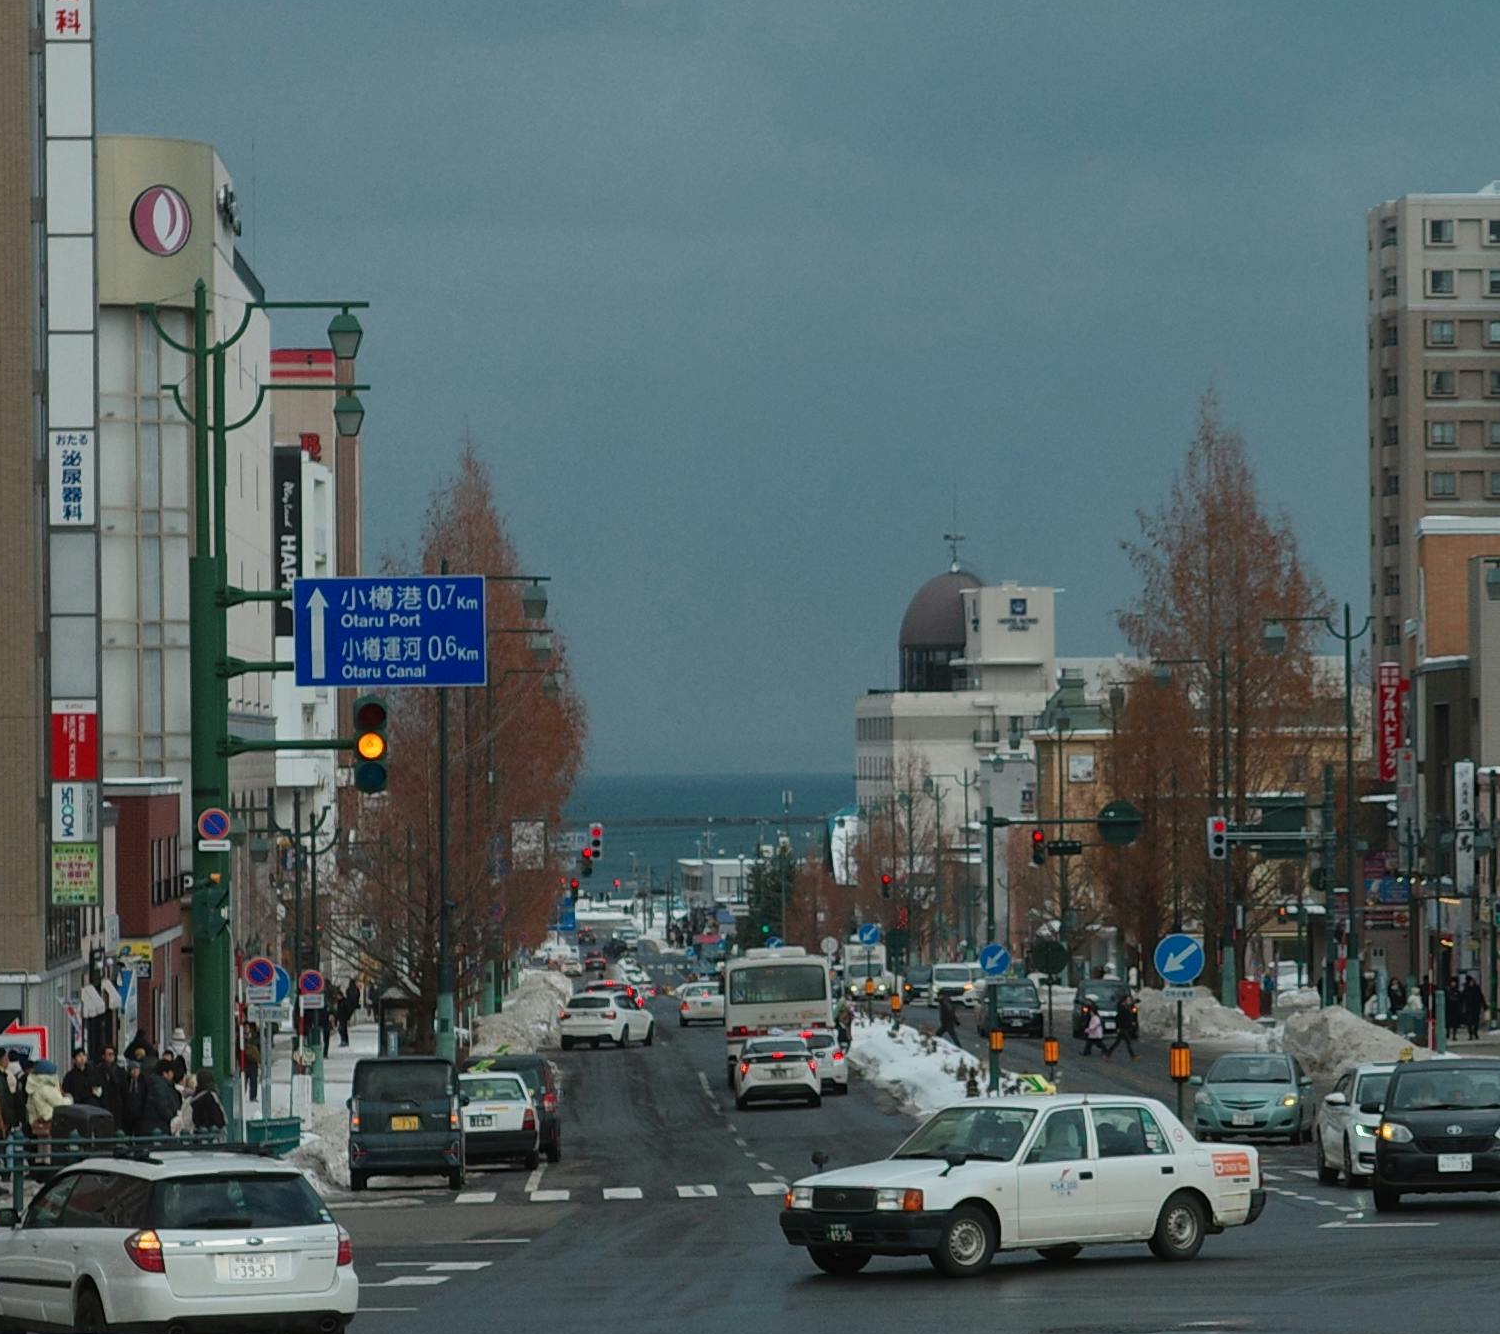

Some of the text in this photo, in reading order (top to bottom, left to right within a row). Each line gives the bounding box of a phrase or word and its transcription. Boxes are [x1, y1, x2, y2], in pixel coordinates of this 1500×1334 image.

[56, 434, 88, 446] おたる
[62, 449, 82, 521] 泌尿器科
[341, 585, 422, 611] 小樽港
[341, 614, 421, 628] Otaru Port
[341, 636, 422, 662] 小樽運河
[342, 665, 426, 679] Otaru Canal
[62, 786, 75, 837] SECOM
[240, 1265, 275, 1278] 39-53
